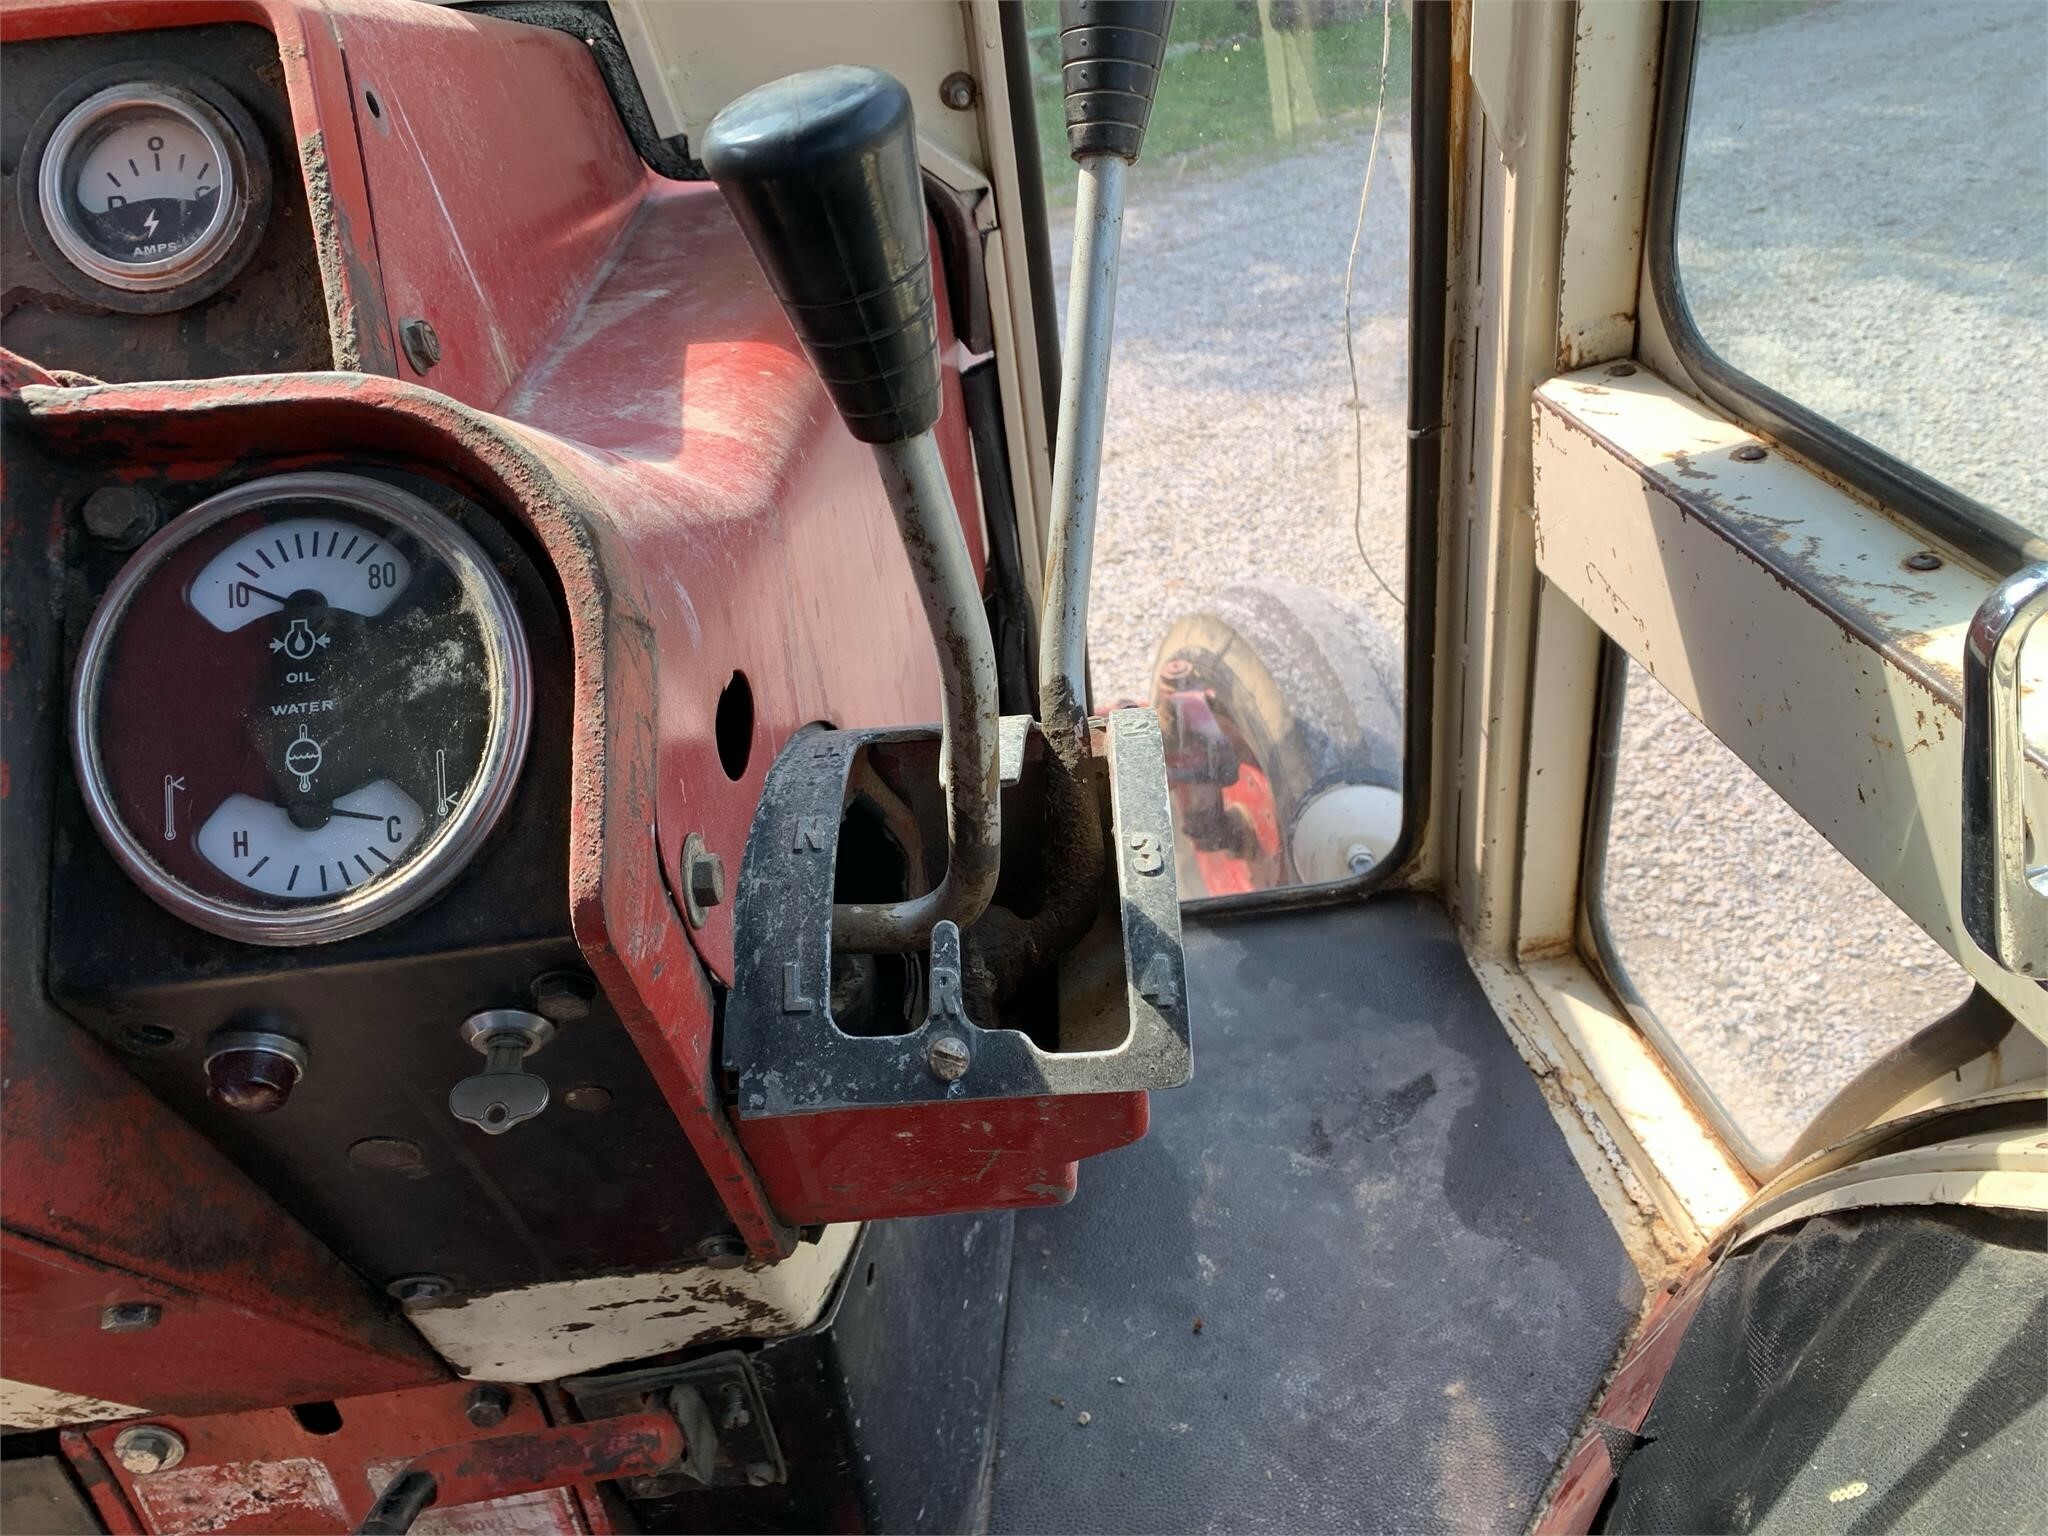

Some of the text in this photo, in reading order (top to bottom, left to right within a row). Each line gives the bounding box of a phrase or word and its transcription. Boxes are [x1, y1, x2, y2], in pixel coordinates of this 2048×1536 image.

[133, 242, 177, 257] AMPS
[367, 562, 397, 590] 80
[228, 582, 250, 609] 10
[286, 671, 316, 684] OIL
[271, 699, 334, 717] WATER
[386, 815, 402, 843] C
[793, 817, 824, 854] N
[232, 830, 250, 858] H
[1130, 830, 1164, 876] 3
[783, 961, 813, 1013] L
[932, 966, 960, 1019] R
[1140, 953, 1177, 1008] 4
